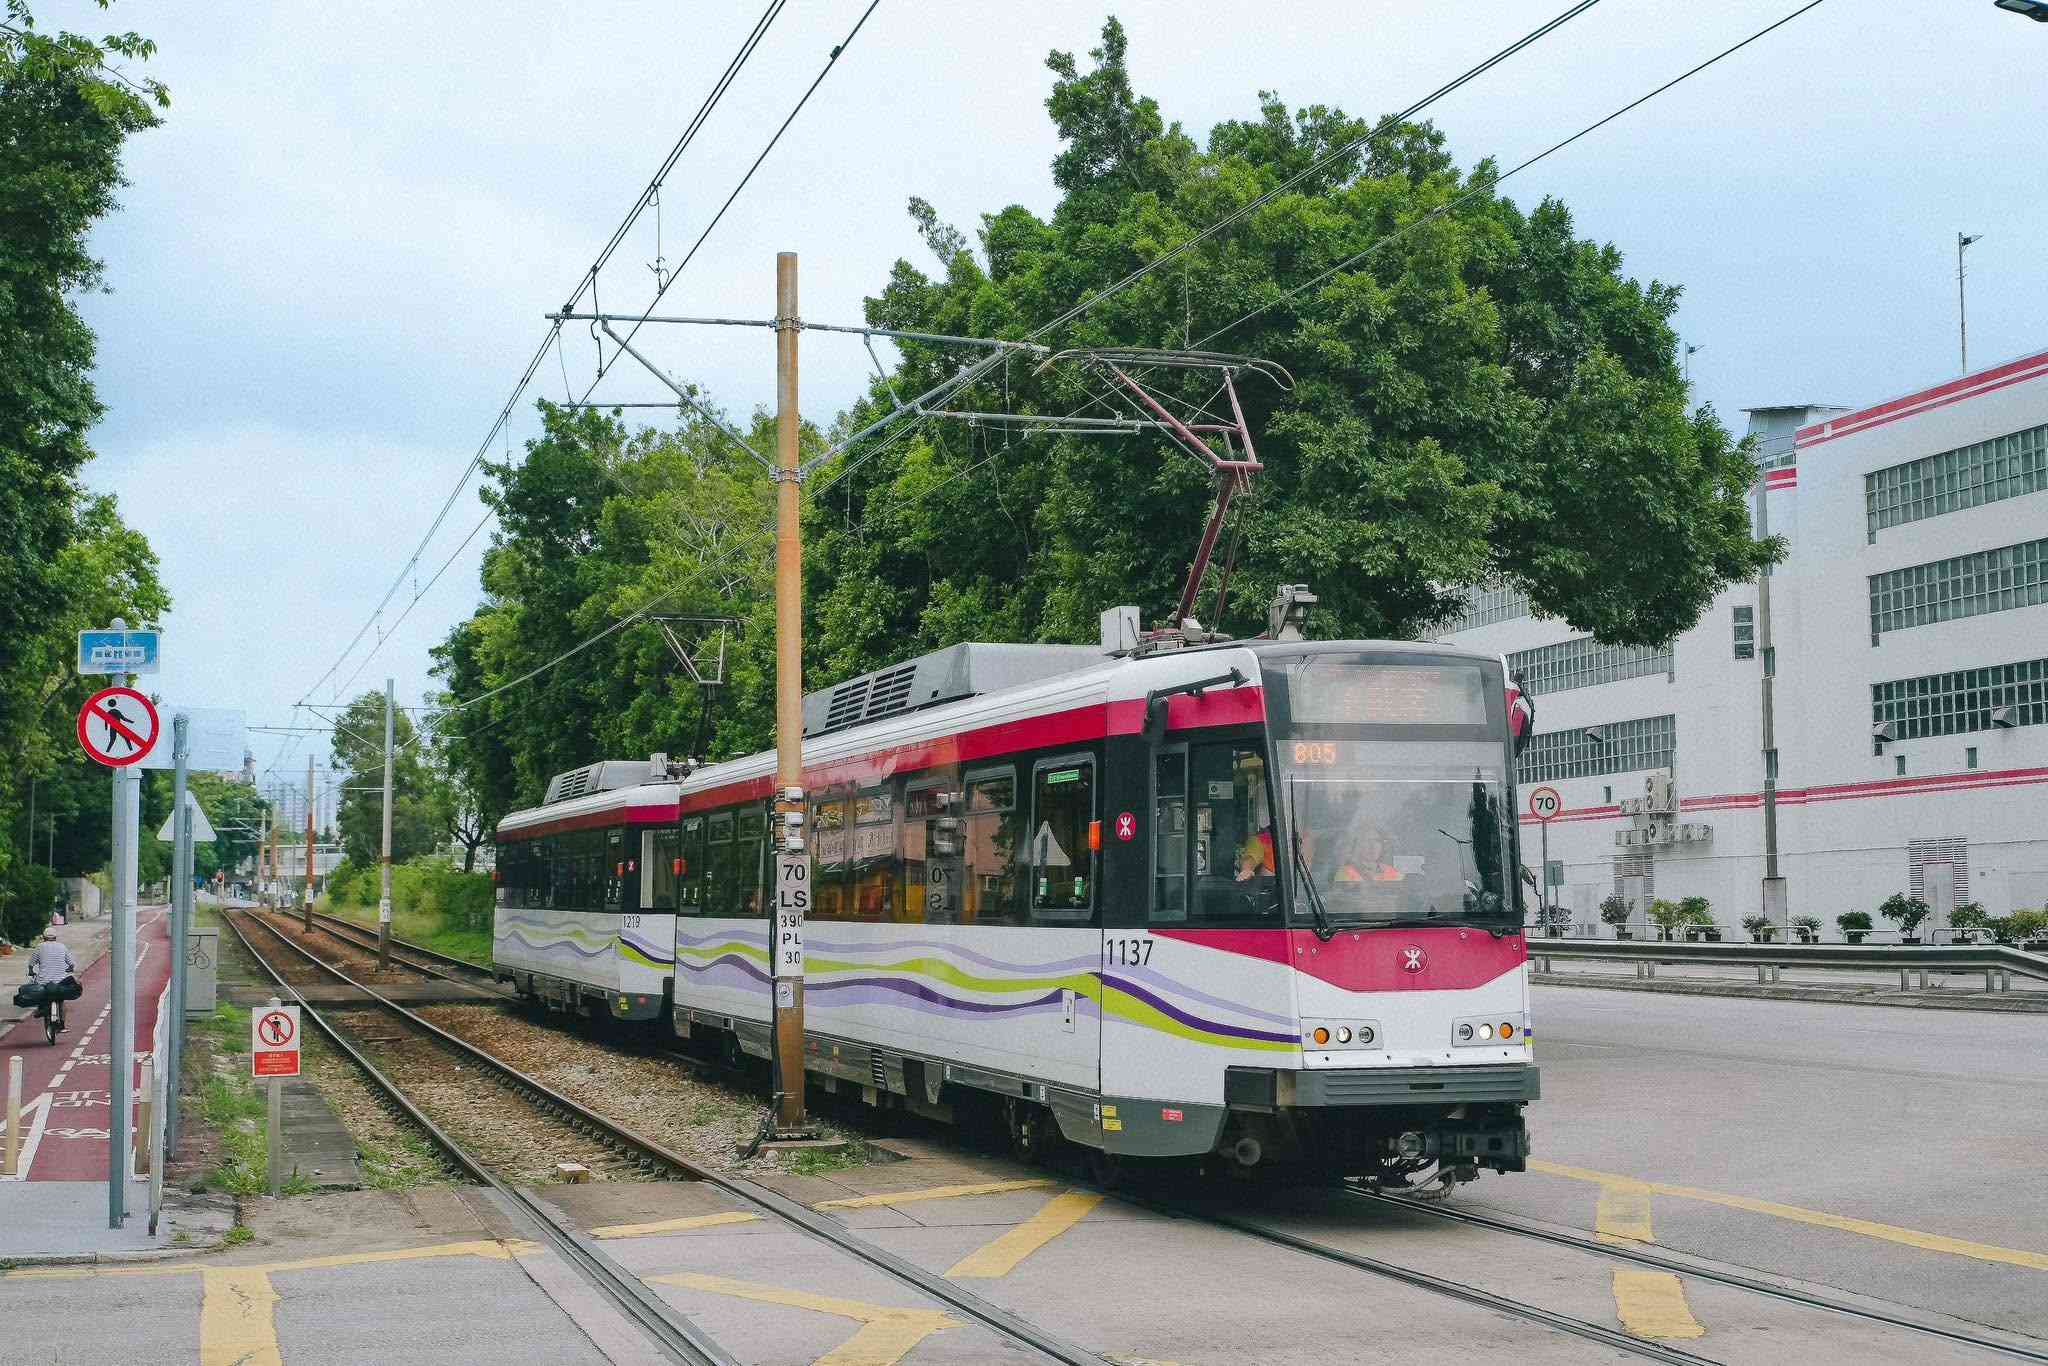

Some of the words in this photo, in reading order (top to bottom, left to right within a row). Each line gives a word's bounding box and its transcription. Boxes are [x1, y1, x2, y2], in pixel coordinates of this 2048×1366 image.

[1535, 797, 1555, 810] 70
[783, 864, 806, 881] 70
[780, 890, 807, 908] LS
[623, 915, 641, 928] 1219
[780, 914, 803, 929] 390
[782, 932, 802, 945] PL
[785, 951, 801, 965] 30
[1106, 938, 1154, 967] 1137
